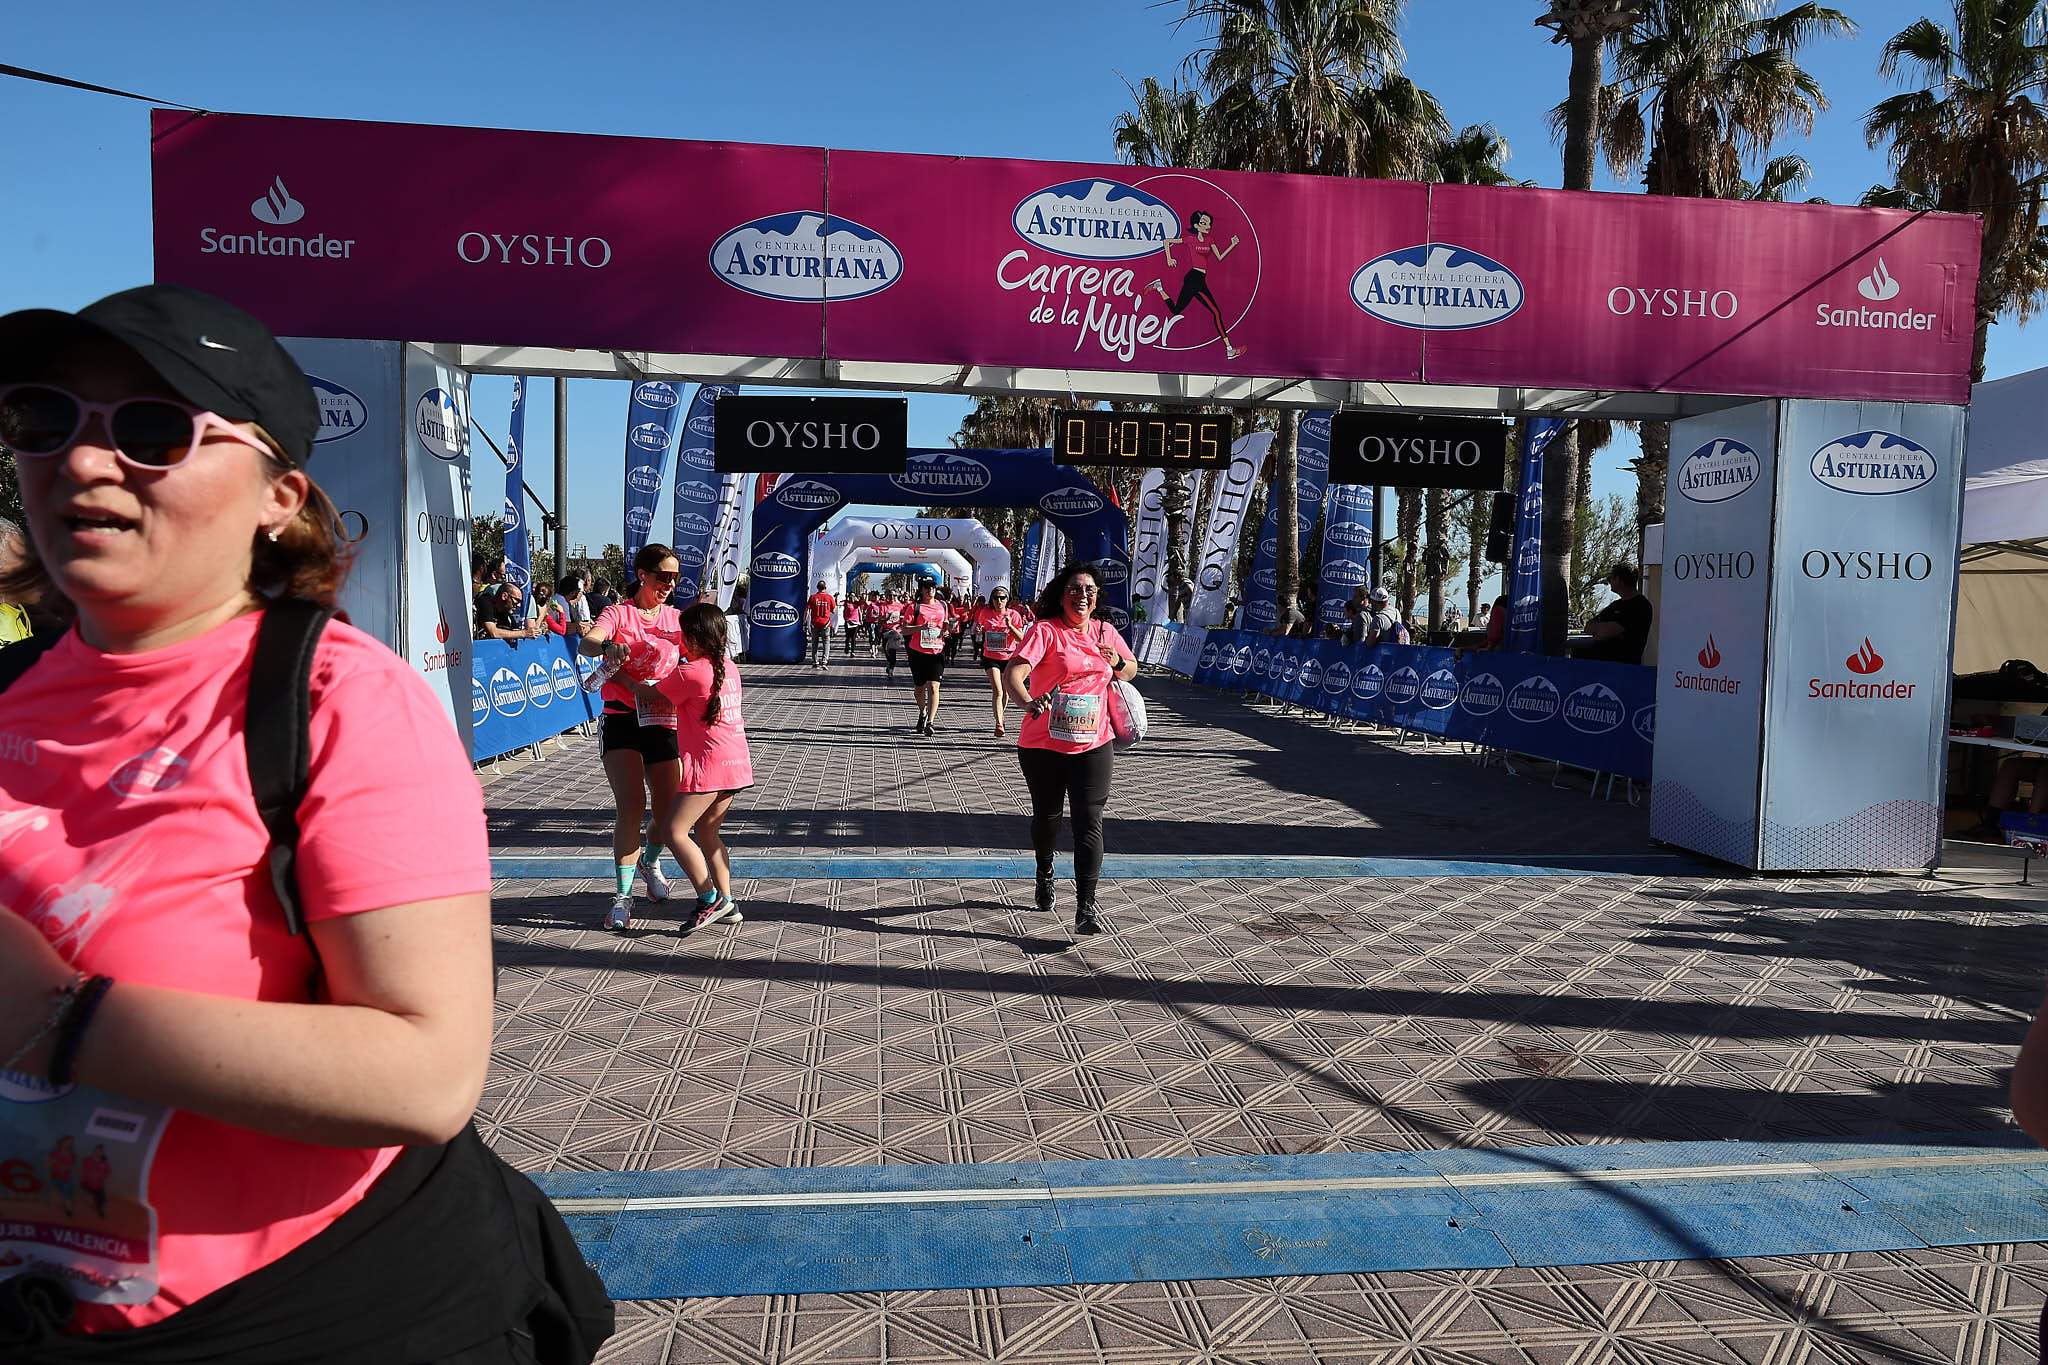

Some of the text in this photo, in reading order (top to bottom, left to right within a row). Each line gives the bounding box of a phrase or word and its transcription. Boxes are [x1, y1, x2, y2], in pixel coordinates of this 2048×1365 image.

[1026, 204, 1166, 241] ASTURIANA
[1052, 204, 1163, 218] CENTRAL LECHERA
[200, 228, 355, 258] Santander
[456, 231, 612, 268] OYSHO
[755, 241, 882, 254] CENTRAL LECHERA
[725, 242, 889, 280] ASTURIANA
[997, 250, 1132, 297] Carrera
[1363, 272, 1510, 309] ASTURIANA
[1391, 271, 1506, 285] CENTRAL LECHERA
[1607, 286, 1739, 318] OYSHO
[1029, 294, 1184, 362] de la Mujer
[1816, 303, 1936, 331] Santander
[746, 420, 881, 452] OYSHO
[1067, 419, 1218, 459] 01:07:35
[1358, 436, 1481, 467] OYSHO
[897, 472, 984, 486] ASTURIANA
[1682, 465, 1753, 490] ASTURIANA
[1819, 453, 1926, 480] ASTURIANA
[781, 491, 836, 504] ASTURIANA
[1046, 499, 1099, 510] ASTURIANA
[418, 512, 465, 546] OYSHO
[872, 523, 951, 541] OYSHO
[1200, 457, 1255, 591] OYSHO
[755, 562, 797, 574] ASTURIANA
[1674, 551, 1754, 580] OYSHO
[1802, 550, 1932, 580] OYSHO
[753, 610, 796, 622] ASTURIANA
[424, 648, 462, 672] Santander
[1421, 682, 1455, 701] ASTURIANA
[1463, 687, 1500, 706] ASTURIANA
[1675, 671, 1741, 695] Santander
[1808, 678, 1916, 699] Santander
[1509, 692, 1555, 713] ASTURIANA
[1566, 701, 1618, 725] ASTURIANA
[53, 1229, 131, 1258] VALENCIA
